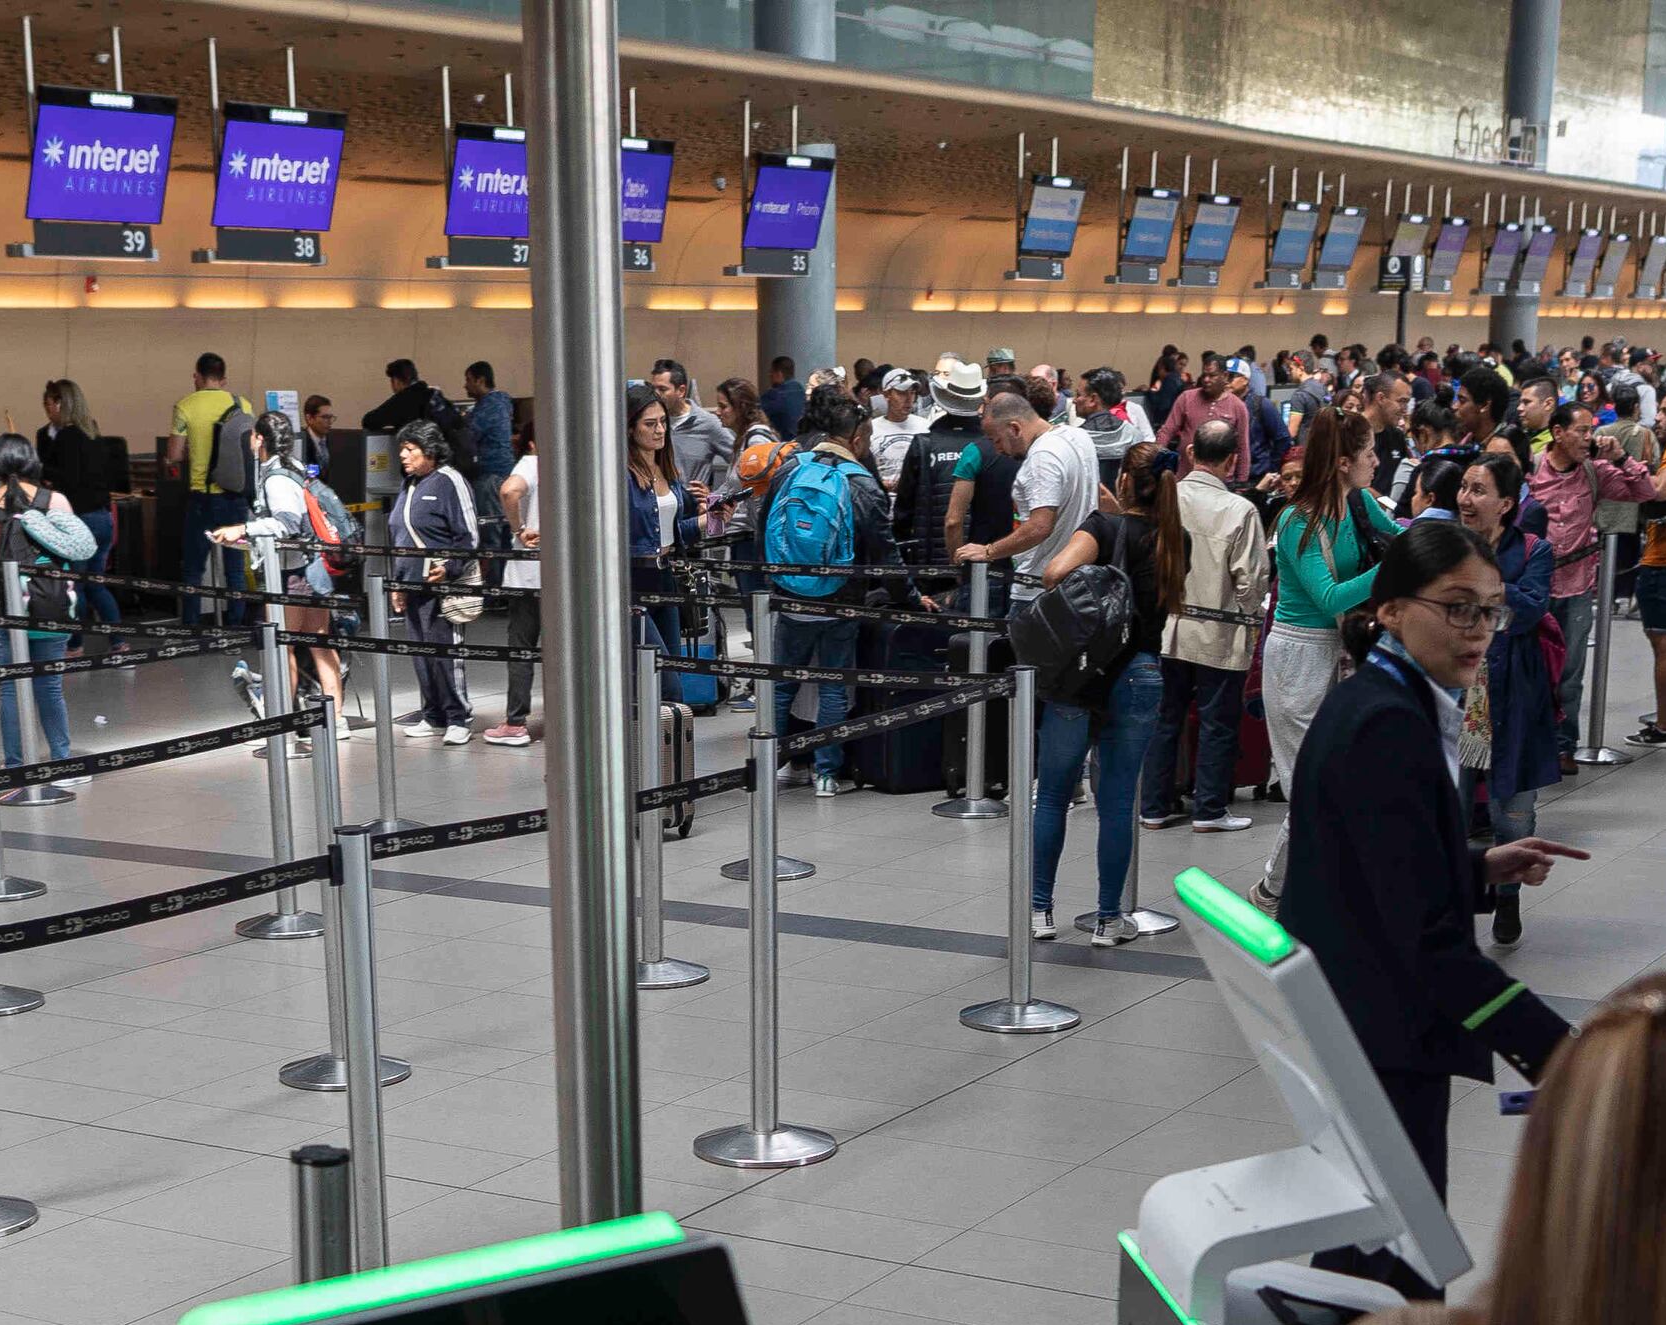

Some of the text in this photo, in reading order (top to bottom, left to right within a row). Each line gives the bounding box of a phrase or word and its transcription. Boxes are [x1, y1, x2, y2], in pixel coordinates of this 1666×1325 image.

[68, 142, 160, 174] interjet
[250, 151, 331, 184] interjet
[64, 176, 157, 197] AIRLINES
[246, 185, 327, 206] AIRLINES
[123, 230, 147, 253] 39
[294, 237, 315, 258] 38
[512, 244, 529, 263] 37
[633, 249, 649, 266] 36
[792, 255, 807, 272] 35
